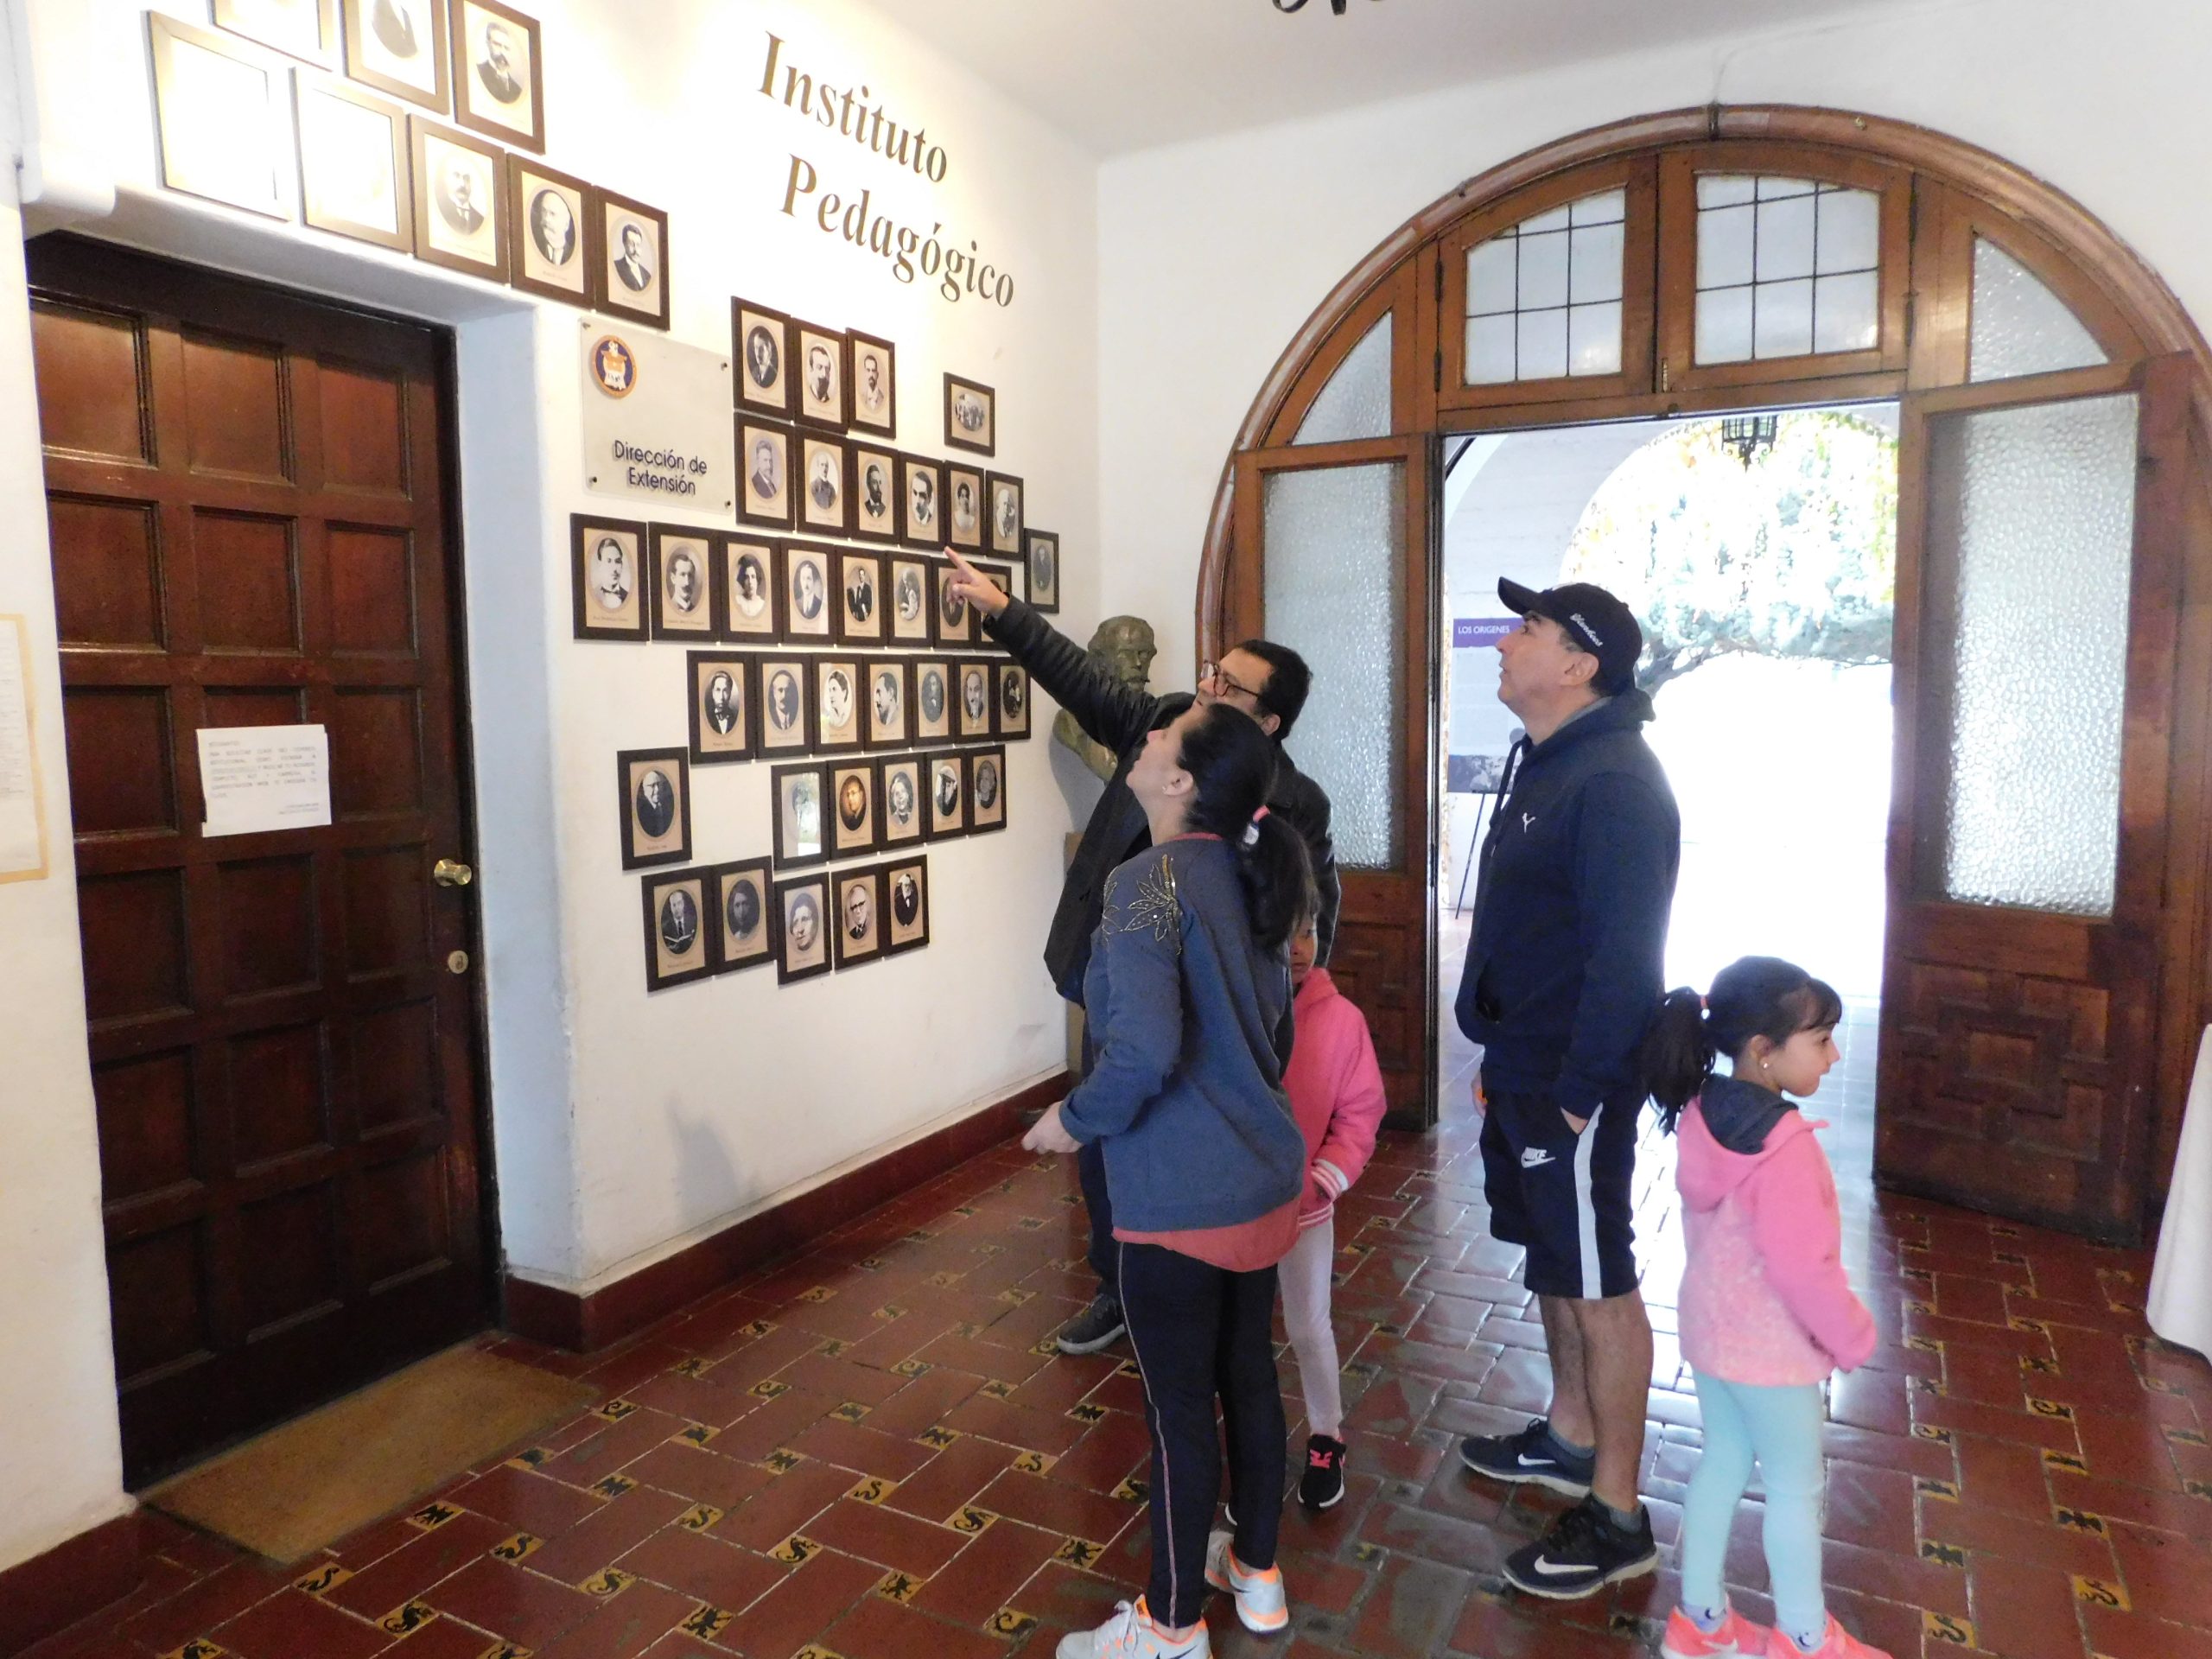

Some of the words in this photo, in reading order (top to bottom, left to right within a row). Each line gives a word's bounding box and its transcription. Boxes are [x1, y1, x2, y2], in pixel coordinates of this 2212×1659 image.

[757, 30, 948, 183] Instituto
[779, 153, 1014, 308] Pedagógico
[613, 439, 684, 472] Dirección
[689, 456, 708, 474] de
[628, 467, 696, 495] Extensión
[1458, 625, 1472, 634] LOS
